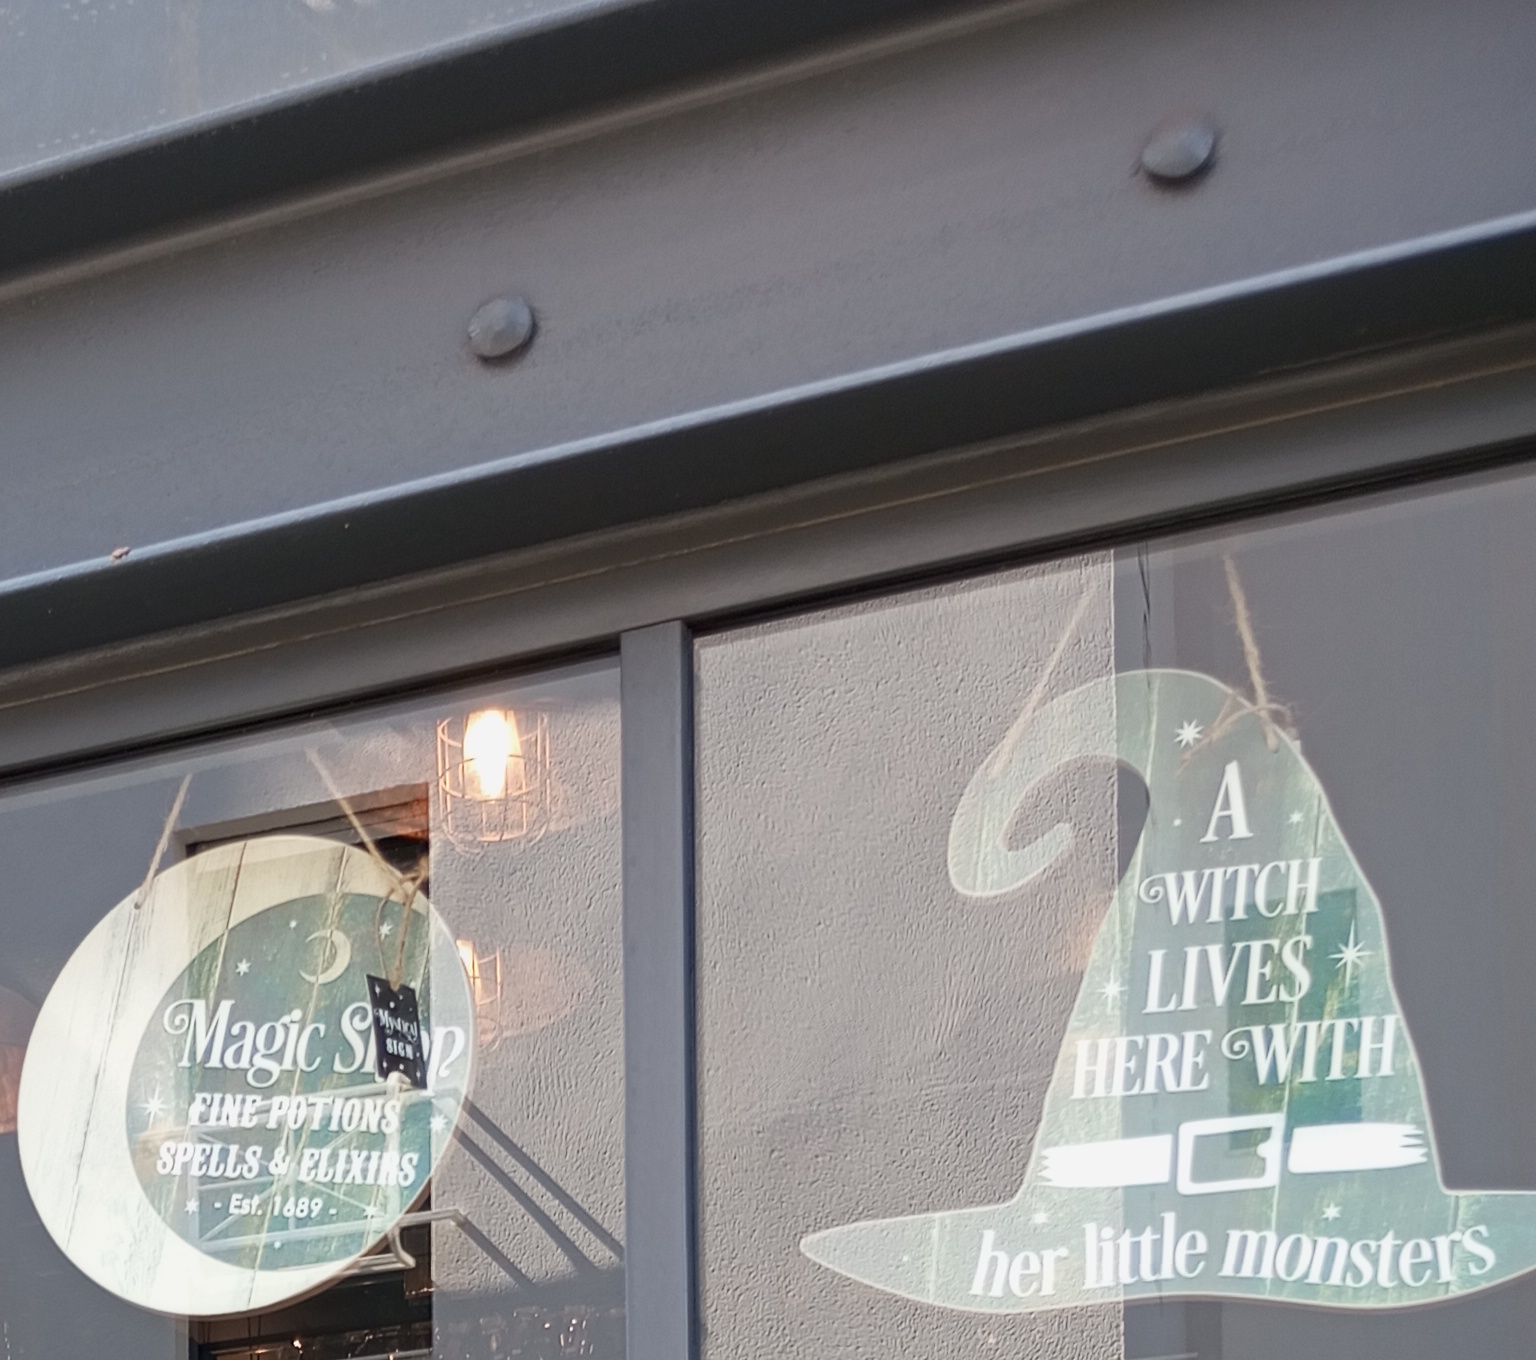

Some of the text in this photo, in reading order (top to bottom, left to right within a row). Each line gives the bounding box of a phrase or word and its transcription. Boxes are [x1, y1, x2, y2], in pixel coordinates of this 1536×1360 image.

[1200, 760, 1253, 843] A
[1138, 858, 1322, 926] WITCH
[1142, 934, 1313, 1014] LIVES
[163, 1000, 464, 1096] Magic Sp
[386, 1038, 414, 1059] SIGN
[1070, 1015, 1400, 1099] HERE WITH
[189, 1092, 401, 1133] FINE POTIONS
[156, 1142, 419, 1187] SPELLS & ELIXIRS
[229, 1194, 322, 1217] Est. 1689
[968, 1213, 1497, 1299] her little monsters
